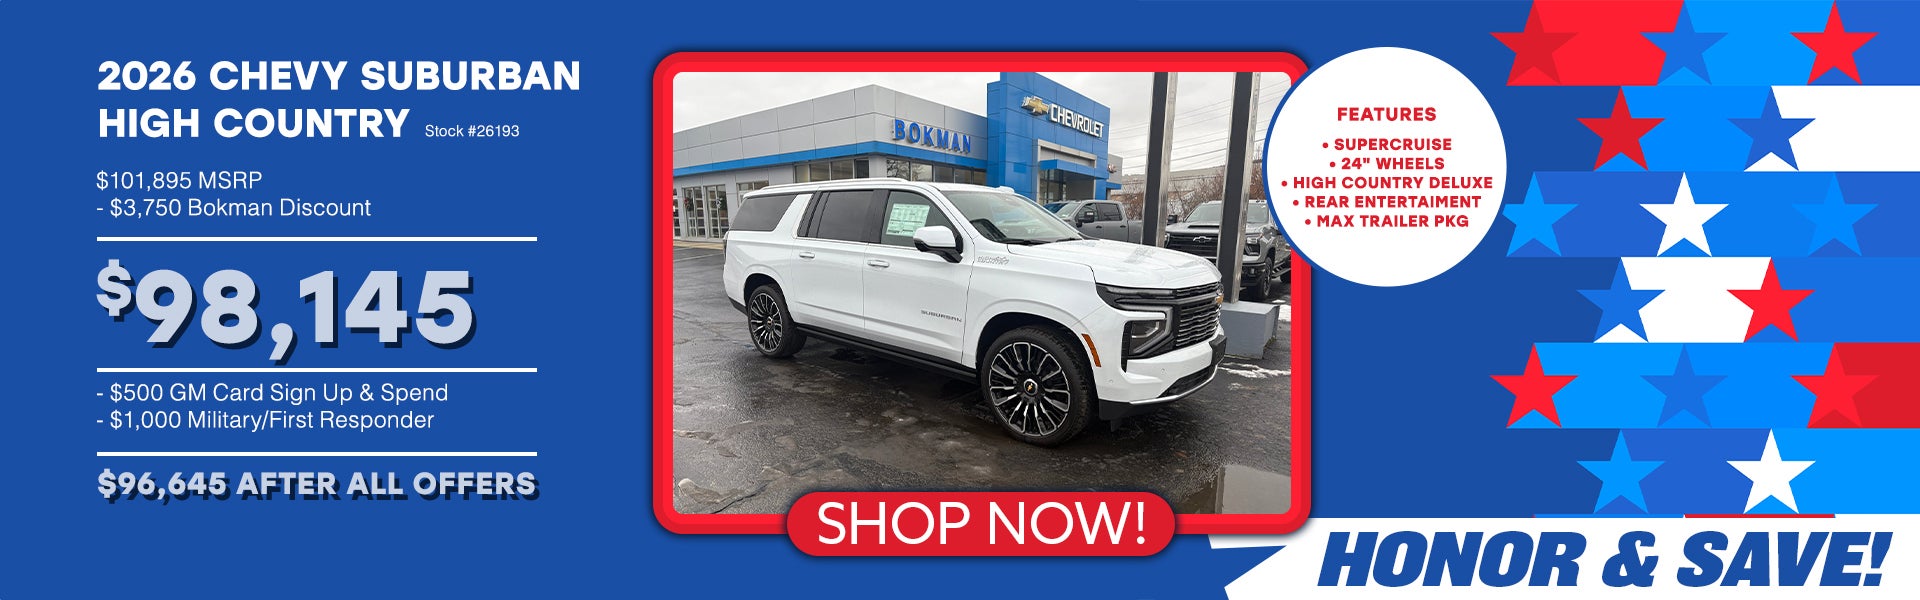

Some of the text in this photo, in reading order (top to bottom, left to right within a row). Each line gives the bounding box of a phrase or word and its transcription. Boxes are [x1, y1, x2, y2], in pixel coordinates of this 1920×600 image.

[894, 118, 971, 154] BOKMAN
[1050, 103, 1104, 138] CHEVROLET
[920, 309, 962, 322] SUBURBAN
